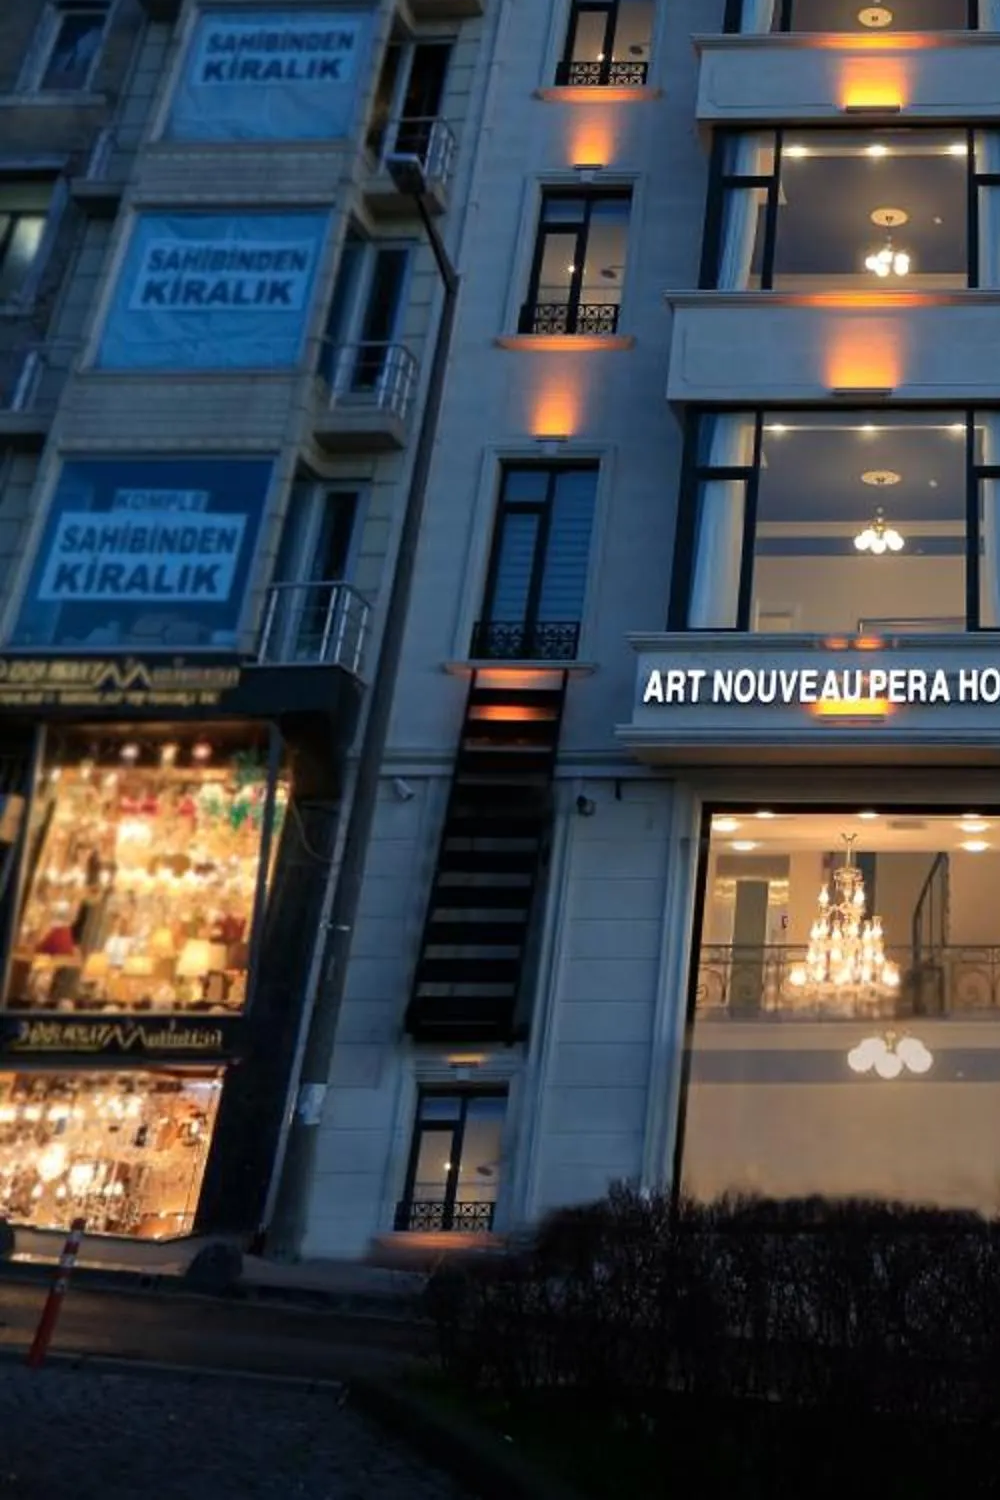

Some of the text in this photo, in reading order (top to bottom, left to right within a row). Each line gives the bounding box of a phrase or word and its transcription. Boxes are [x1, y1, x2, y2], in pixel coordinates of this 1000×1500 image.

[202, 53, 342, 82] KİRALIK
[140, 274, 293, 306] KİRALIK
[59, 521, 237, 555] SAHİBİNDEN
[52, 556, 221, 595] KİRALIK
[643, 668, 706, 704] ART
[712, 668, 863, 703] NOUVEAU
[869, 668, 950, 703] PERA
